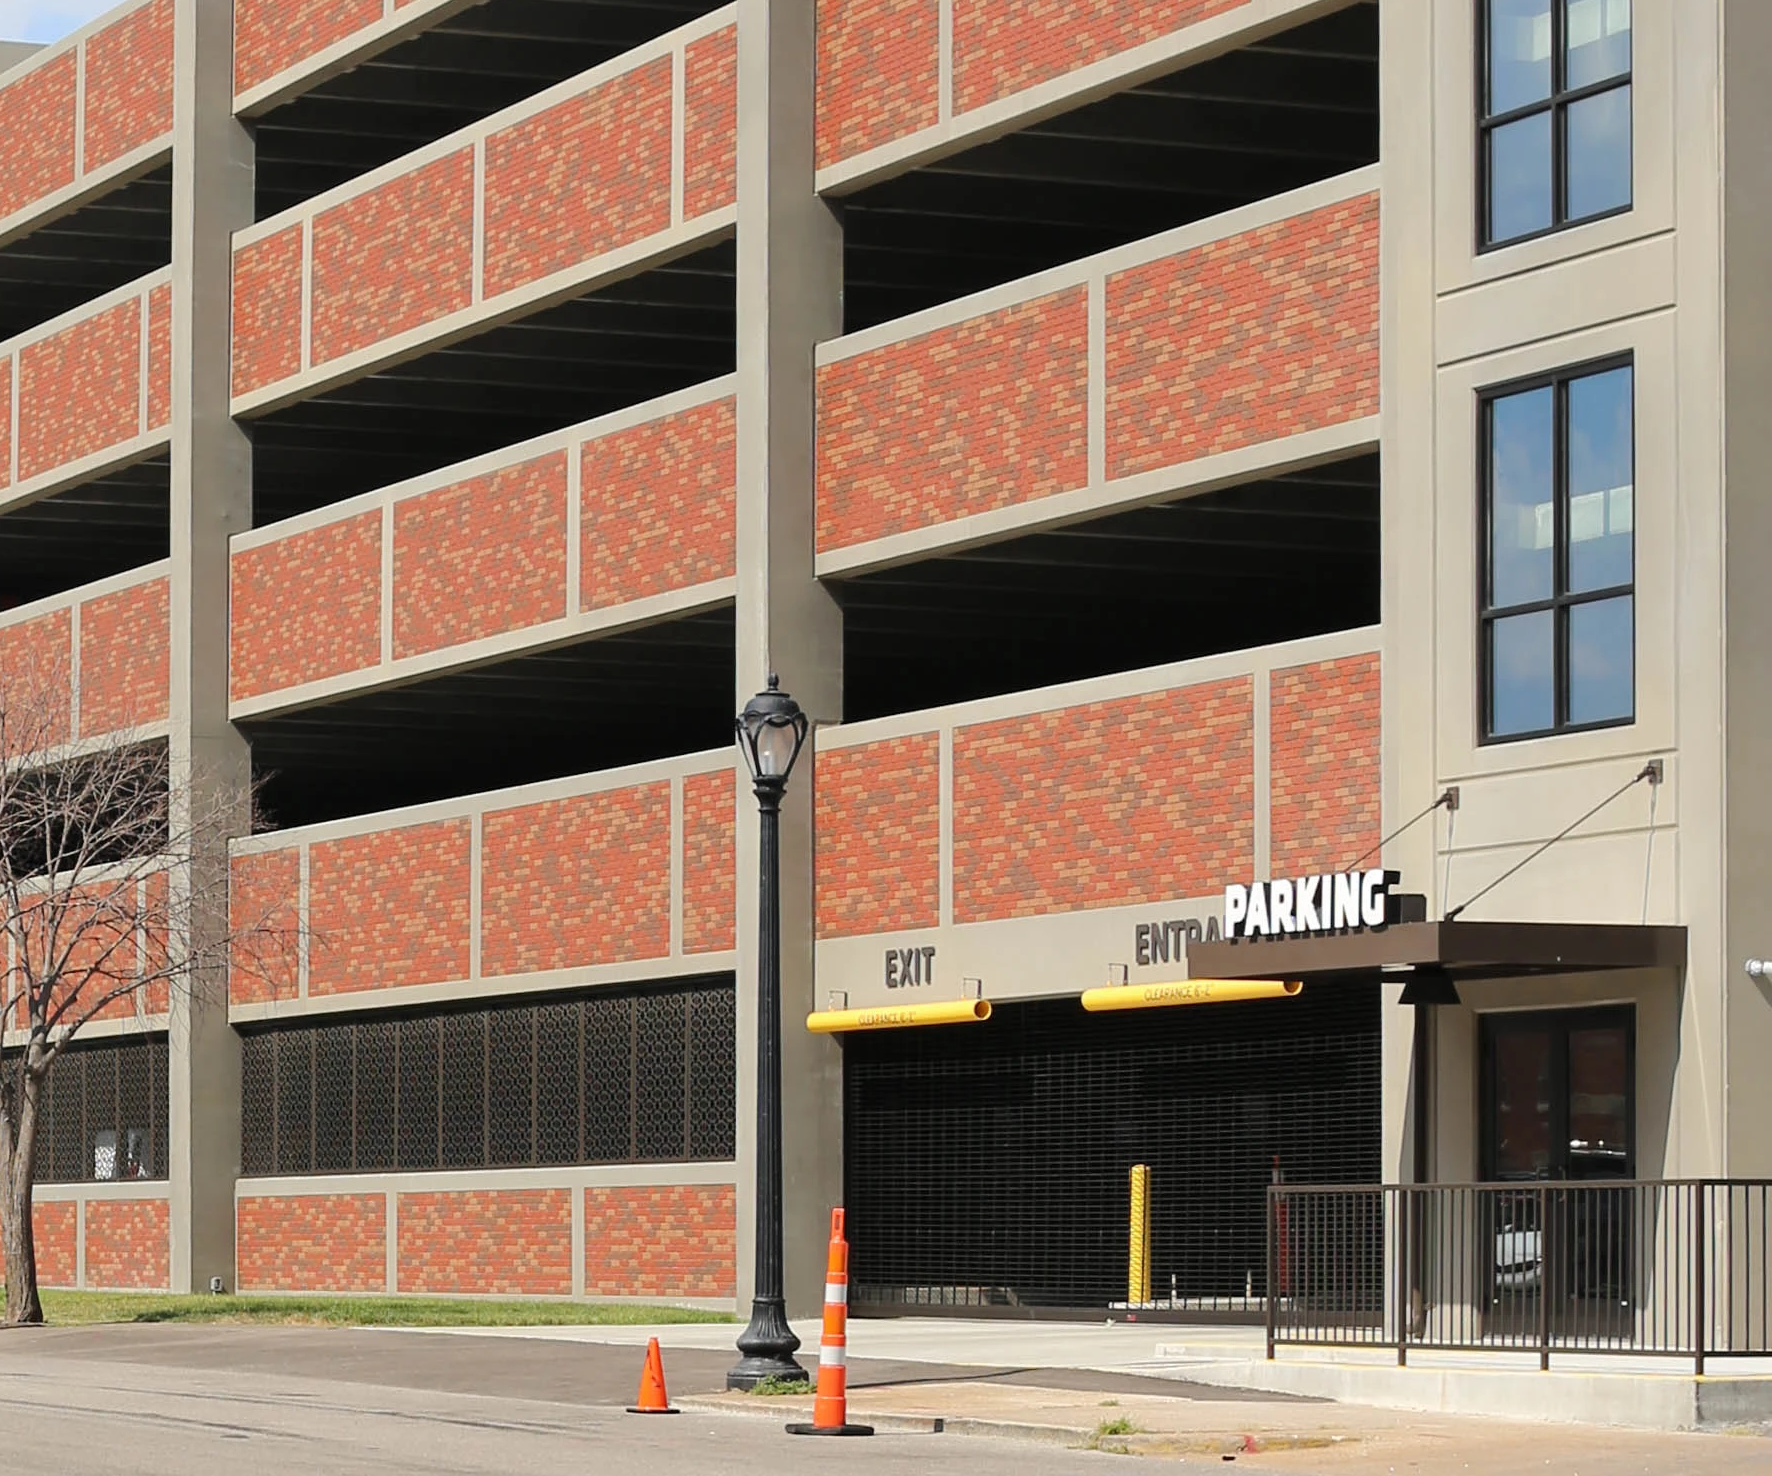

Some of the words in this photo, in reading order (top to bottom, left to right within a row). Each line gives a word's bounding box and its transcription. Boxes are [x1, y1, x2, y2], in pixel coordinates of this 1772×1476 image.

[1225, 869, 1387, 939] PARKING
[1136, 916, 1225, 965] ENTRA
[885, 946, 936, 989] EXIT
[1145, 986, 1193, 1001] CLEARANCE
